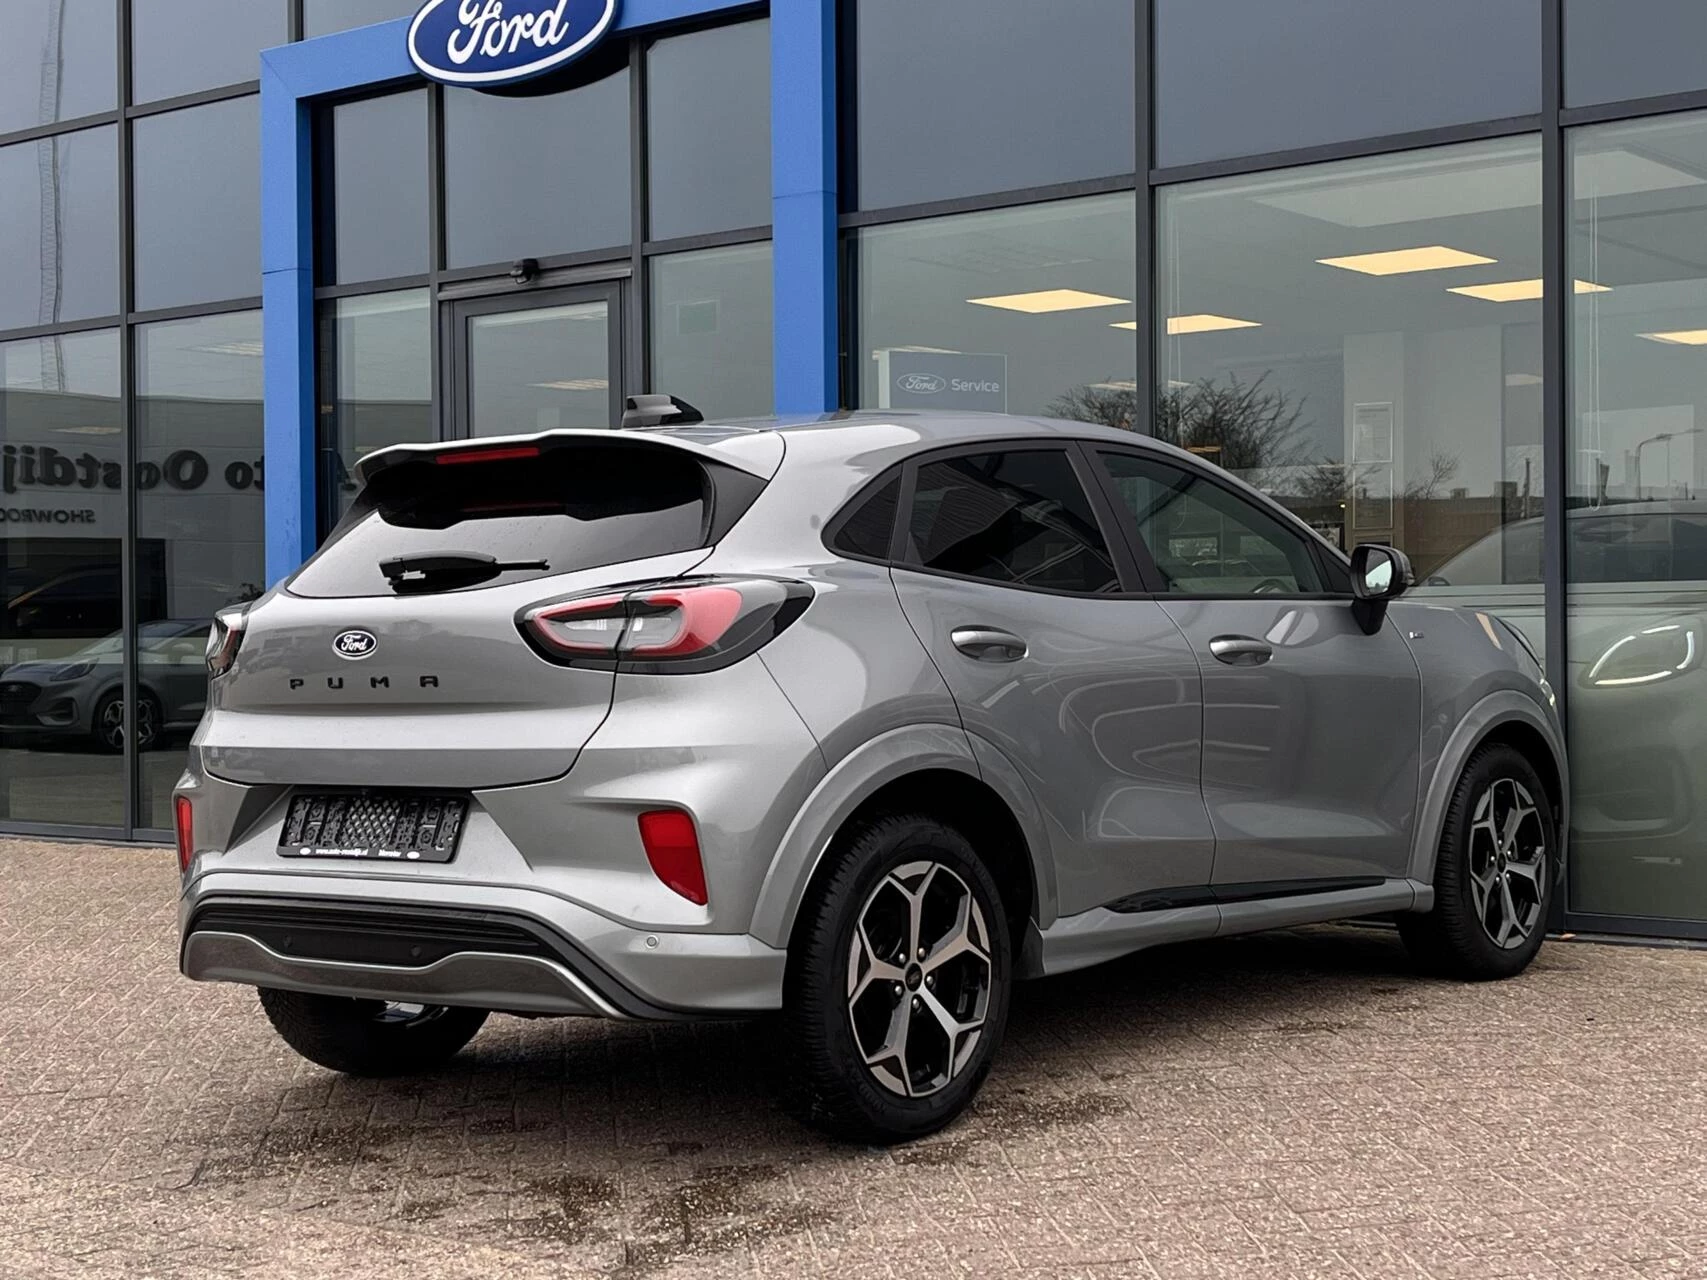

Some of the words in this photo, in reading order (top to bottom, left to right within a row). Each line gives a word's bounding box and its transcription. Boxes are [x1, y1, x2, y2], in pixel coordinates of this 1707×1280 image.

[447, 0, 570, 64] Ford
[905, 375, 937, 391] Ford
[951, 378, 1000, 393] Service
[340, 633, 368, 652] Ford
[289, 675, 439, 691] PUMA
